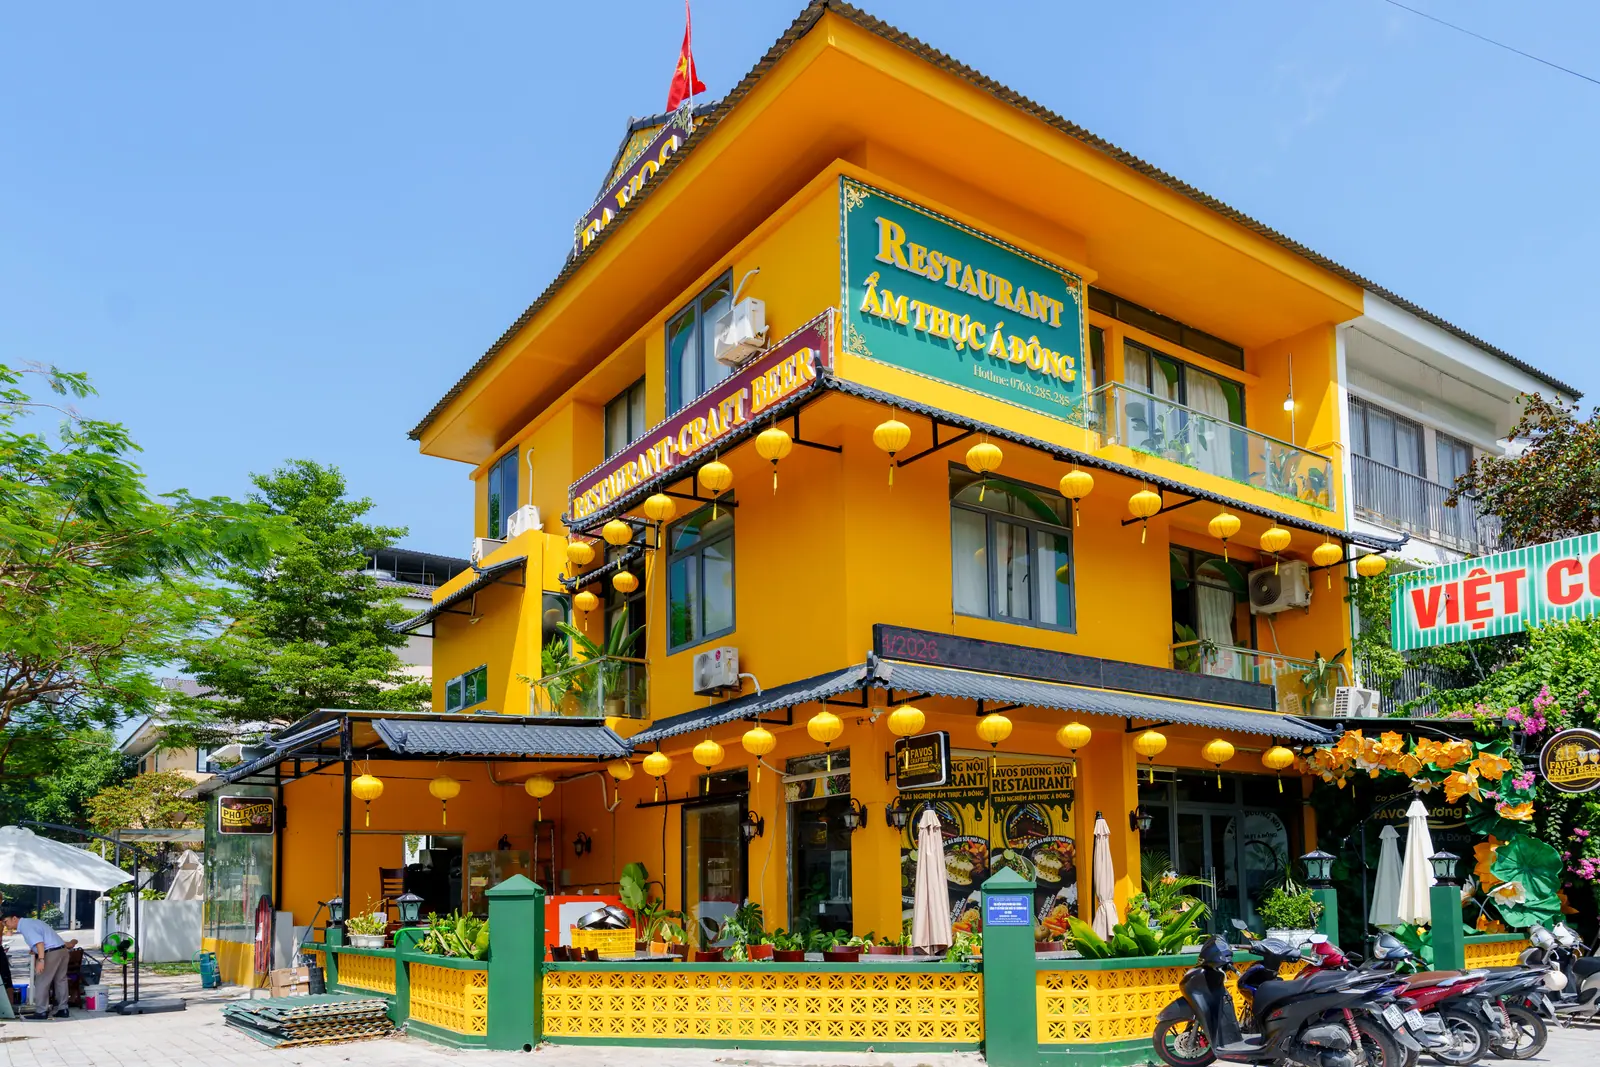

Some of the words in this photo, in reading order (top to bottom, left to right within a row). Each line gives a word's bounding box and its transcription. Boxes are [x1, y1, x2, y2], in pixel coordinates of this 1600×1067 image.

[875, 215, 1064, 328] RESTAURANT
[860, 271, 910, 326] ẨM
[911, 299, 987, 352] THỰC
[988, 321, 1008, 359] Á
[1008, 334, 1076, 384] ĐÔNG
[751, 347, 817, 414] BEER
[973, 364, 1009, 387] Hotline:
[1010, 378, 1070, 407] 0768.285.285
[1410, 568, 1526, 632] VIỆT
[910, 746, 933, 759] FAVOS
[1549, 758, 1578, 769] FAVOS
[992, 776, 1071, 792] RESTAURANT
[244, 804, 270, 817] FAVOS
